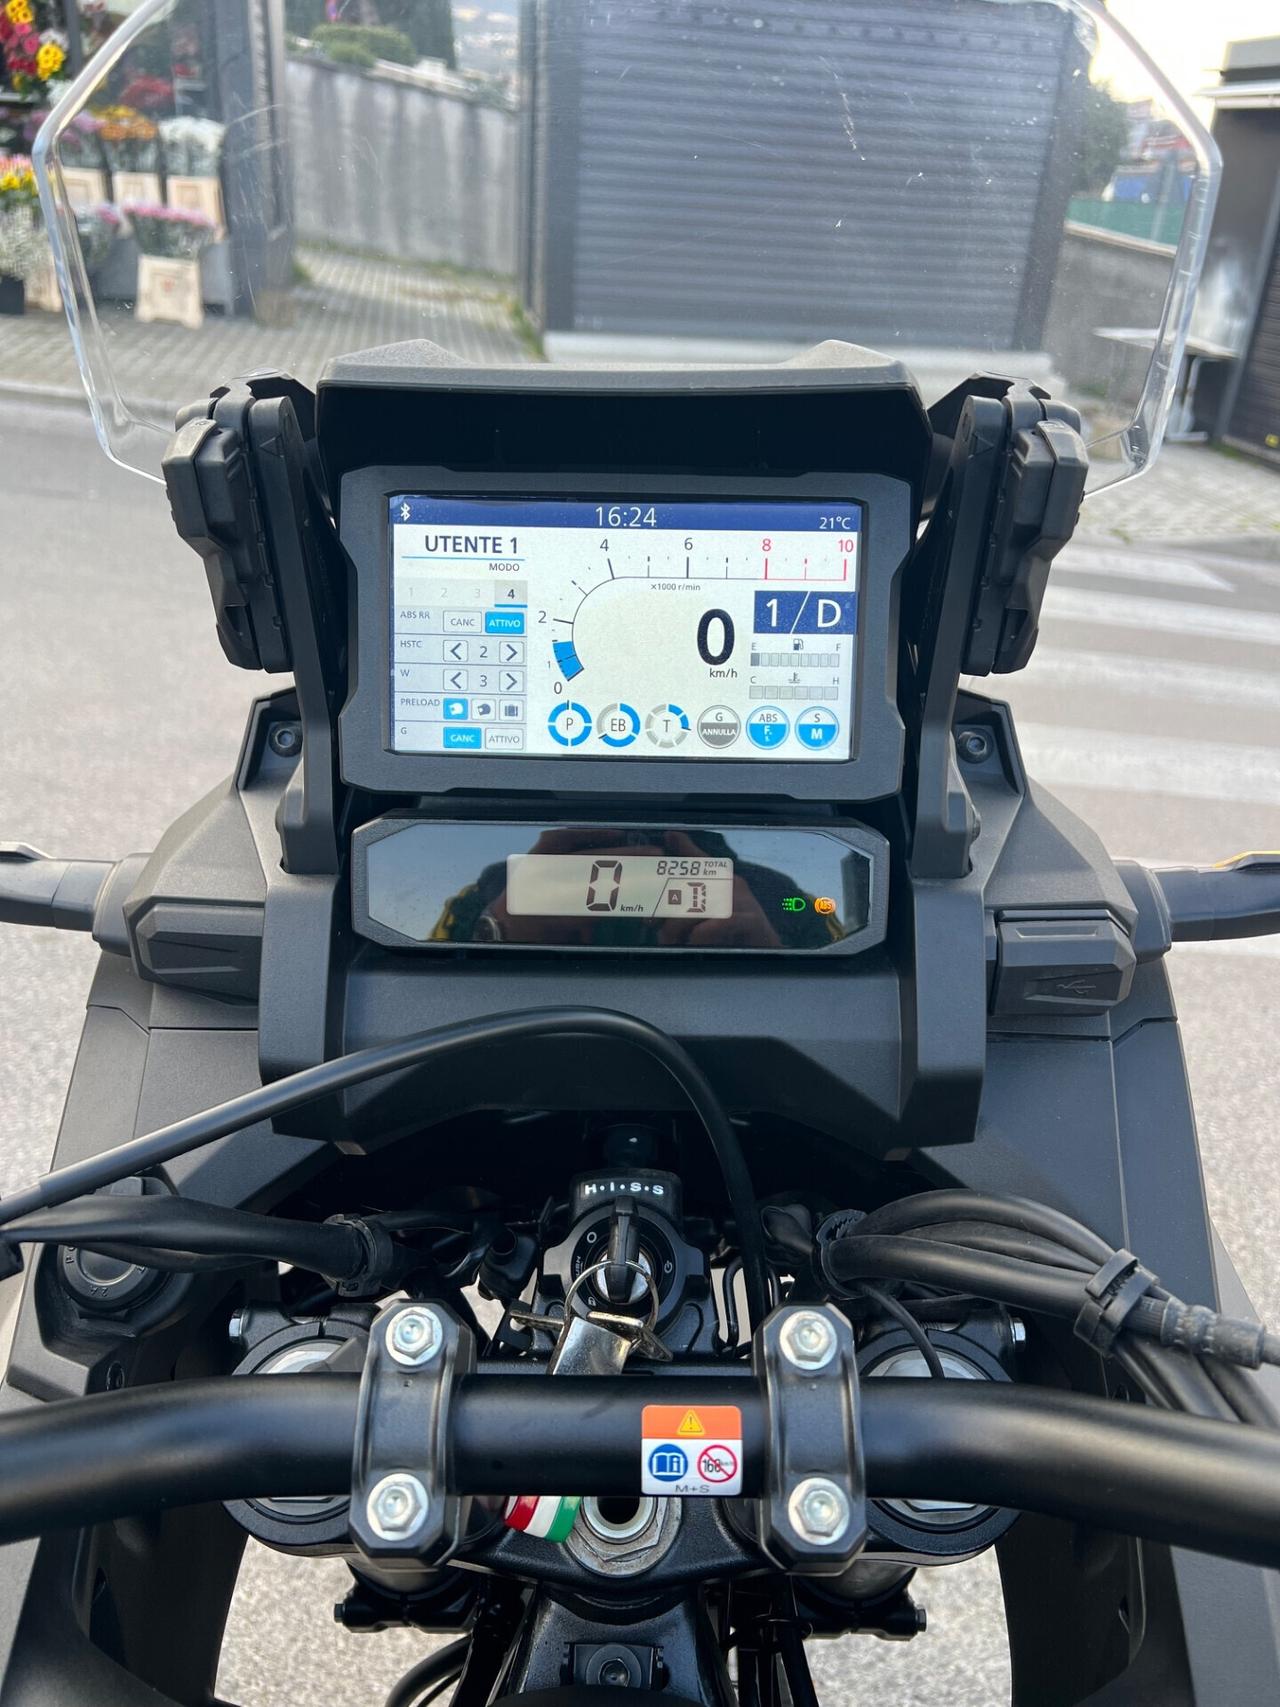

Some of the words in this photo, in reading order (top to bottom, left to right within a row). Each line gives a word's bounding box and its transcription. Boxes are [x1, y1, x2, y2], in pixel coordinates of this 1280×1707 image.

[595, 506, 657, 527] 16:24
[818, 516, 852, 530] 21°C
[424, 534, 503, 554] UTENTE
[509, 536, 518, 554] 1
[599, 538, 609, 551] 4
[683, 537, 693, 551] 6
[761, 538, 772, 552] 8
[837, 538, 854, 552] 10
[488, 562, 520, 572] MODO
[677, 582, 701, 591] r/min
[507, 588, 516, 599] 4
[400, 610, 417, 619] ABS
[418, 611, 430, 620] RR
[538, 610, 547, 624] 2
[765, 598, 777, 627] 1
[816, 598, 842, 628] D
[450, 618, 476, 627] CANC
[488, 619, 521, 628] ATTIVO
[696, 608, 735, 666] 0
[400, 640, 423, 648] HSTC
[751, 642, 757, 651] E
[835, 643, 841, 652] F
[479, 646, 488, 658] 2
[400, 669, 410, 677] W
[709, 667, 738, 678] km/h
[479, 675, 488, 687] 3
[750, 676, 756, 684] C
[832, 677, 839, 685] H
[553, 681, 563, 694] 0
[400, 698, 440, 707] PRELOAD
[715, 711, 723, 722] G
[759, 713, 778, 723] ABS
[814, 713, 821, 723] S
[566, 718, 574, 730] P
[611, 718, 626, 732] EB
[663, 719, 671, 732] T
[400, 727, 407, 735] G
[702, 728, 736, 736] ANNULLA
[811, 728, 823, 740] M
[450, 734, 476, 743] CANC
[488, 735, 520, 744] ATTIVO
[656, 860, 701, 876] 8258
[703, 868, 717, 876] km
[586, 860, 623, 912] 0
[619, 903, 644, 913] km/h
[674, 1484, 710, 1493] M+S
